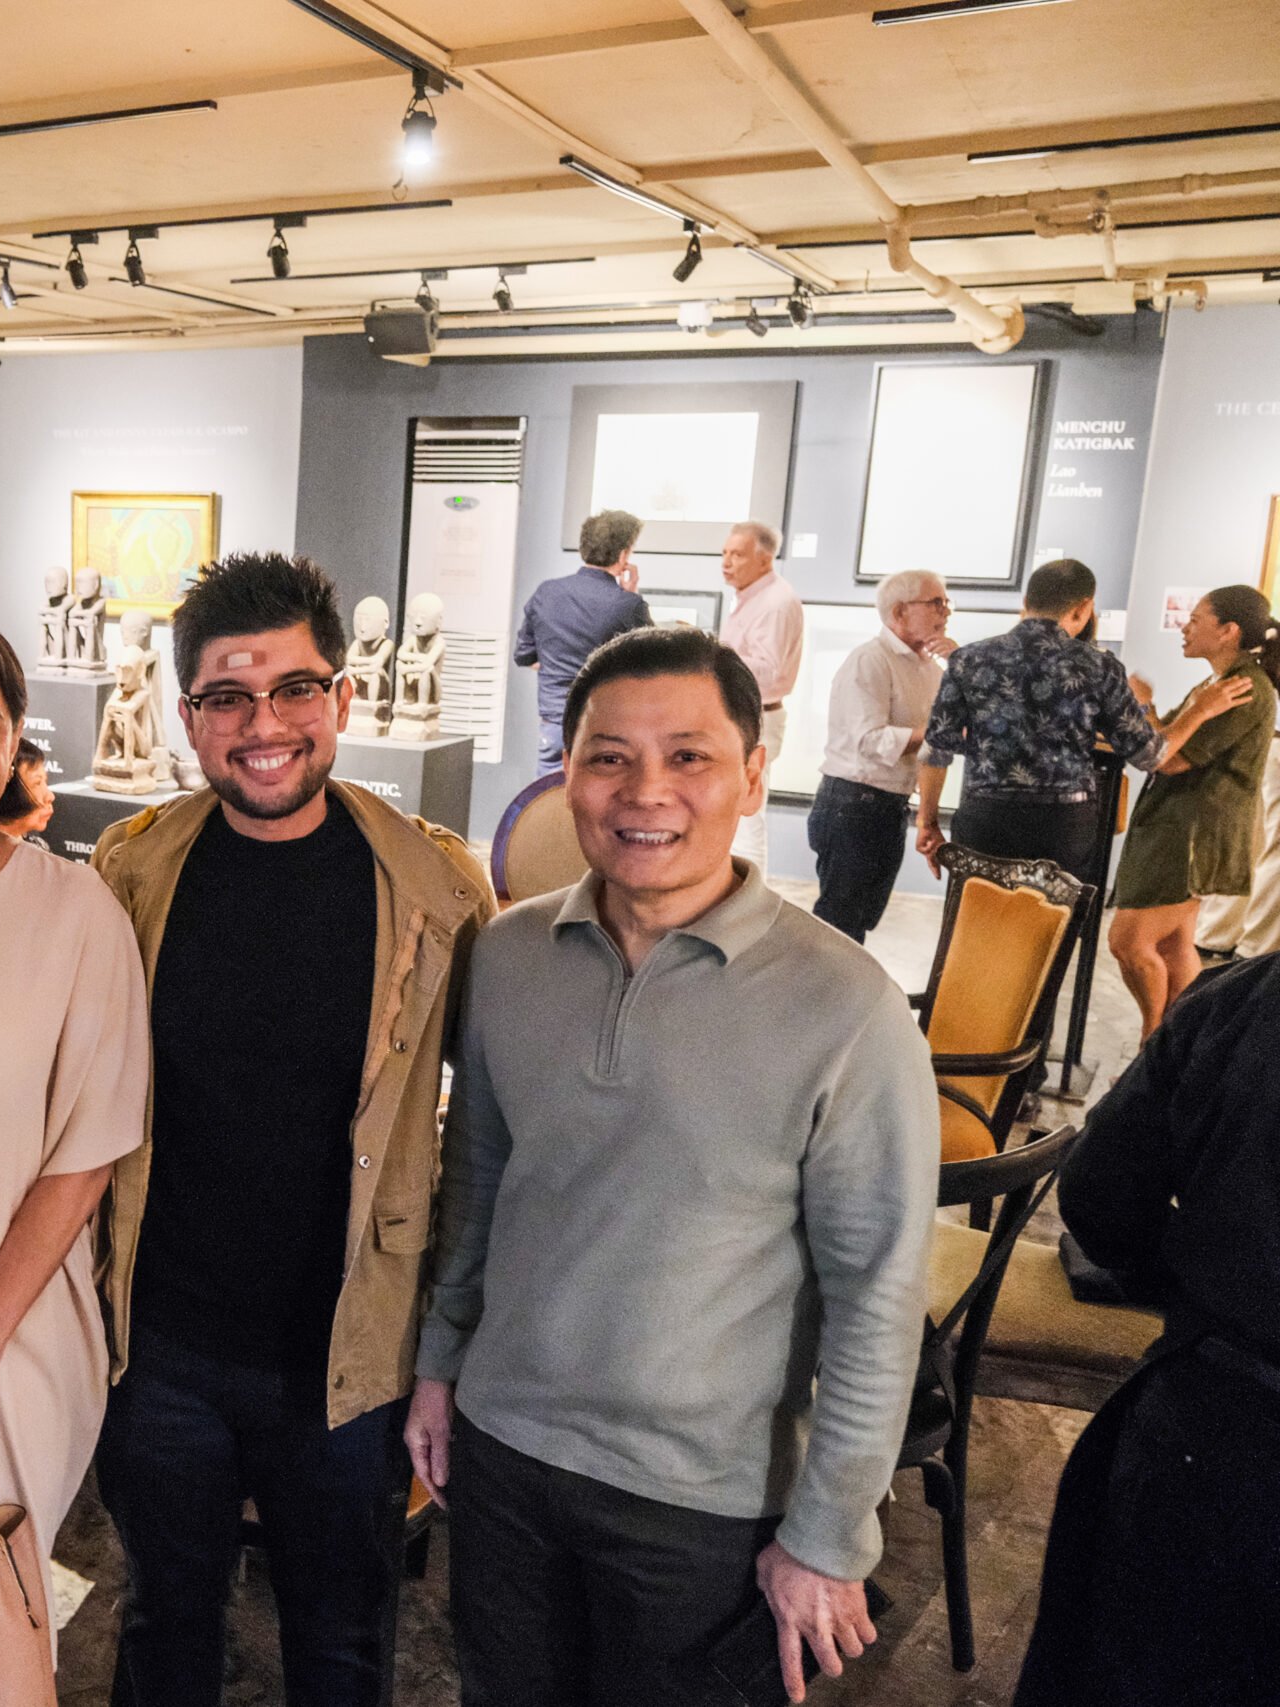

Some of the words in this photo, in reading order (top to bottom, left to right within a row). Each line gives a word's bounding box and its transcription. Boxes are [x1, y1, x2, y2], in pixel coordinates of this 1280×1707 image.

[1216, 402, 1251, 416] THE
[1056, 420, 1126, 434] MENCHU
[1053, 437, 1135, 450] KATIGBAK
[1050, 463, 1077, 478] Lao
[1047, 482, 1103, 497] Lianben
